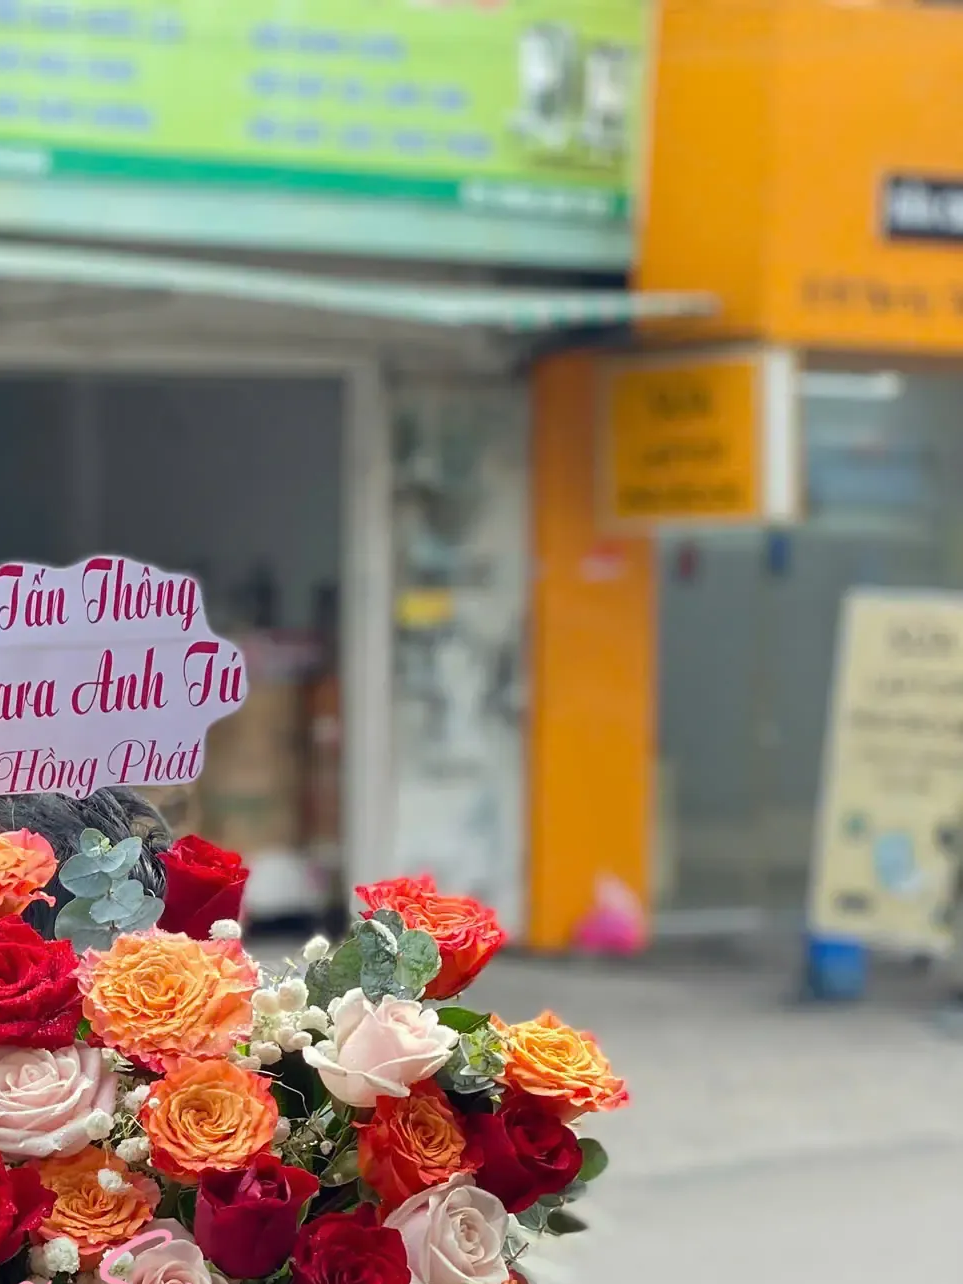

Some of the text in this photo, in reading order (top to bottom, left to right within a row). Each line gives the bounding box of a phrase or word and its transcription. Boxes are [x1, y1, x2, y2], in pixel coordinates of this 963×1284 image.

[82, 557, 200, 632] Thông
[71, 646, 169, 716] Anh
[183, 640, 245, 707] Tú
[107, 738, 202, 785] Phát
